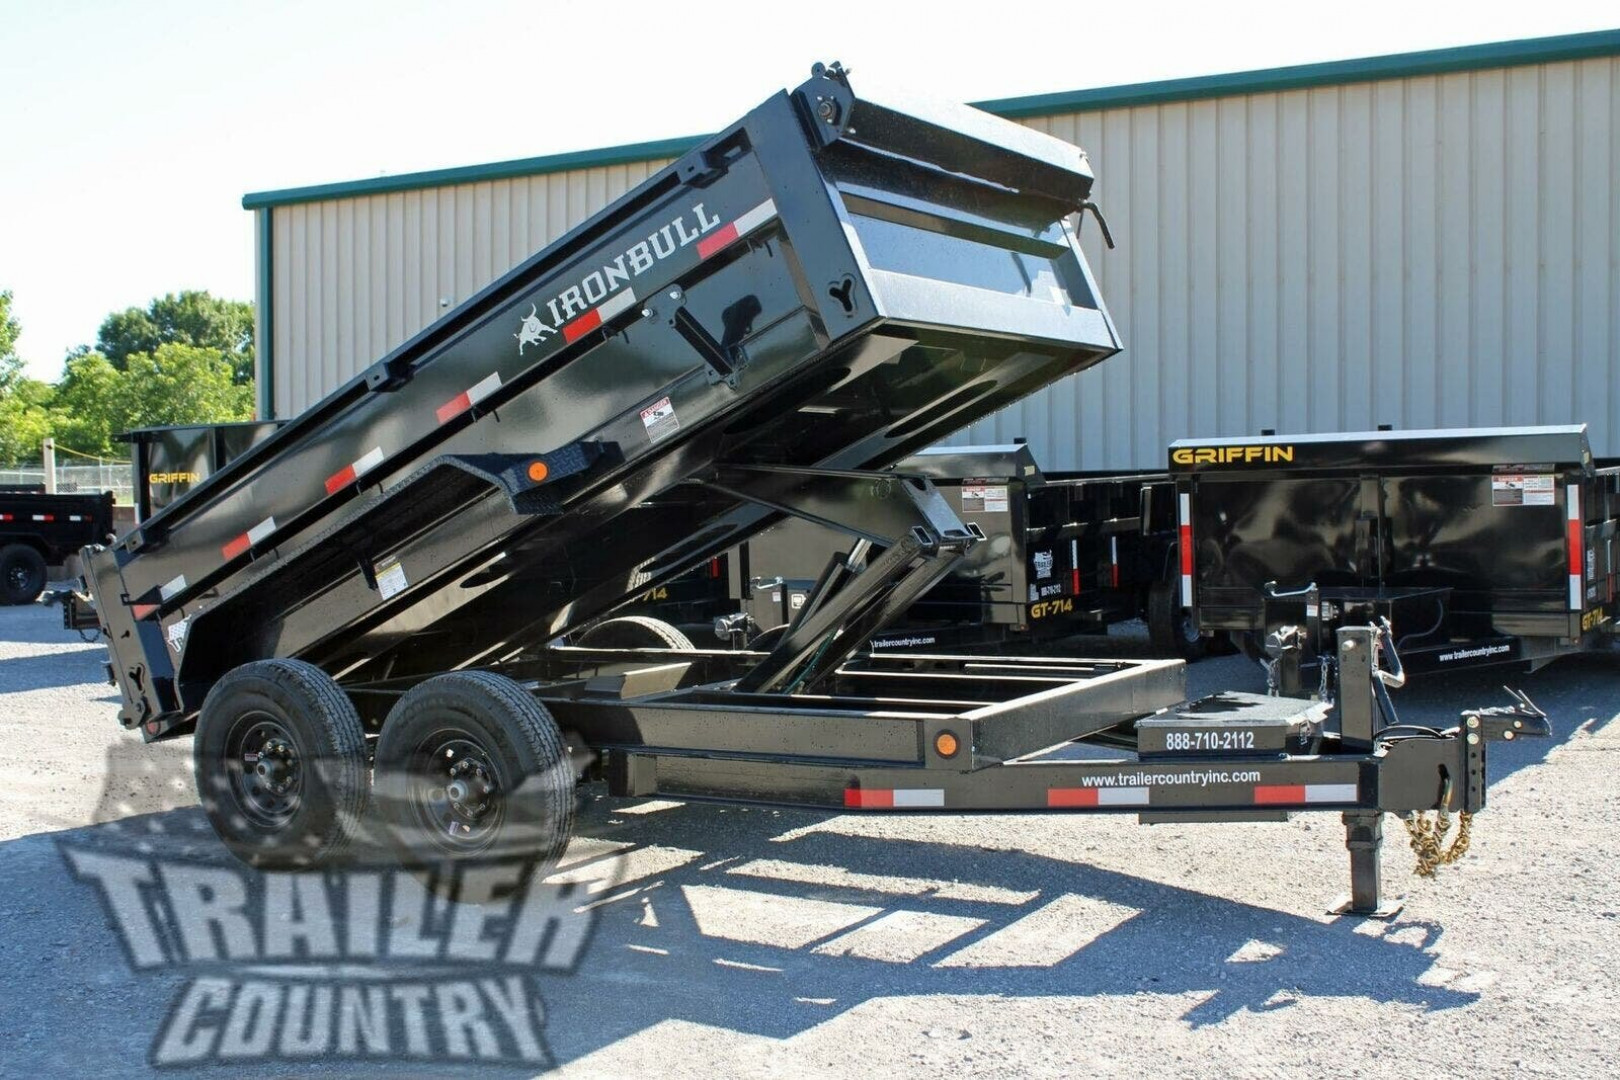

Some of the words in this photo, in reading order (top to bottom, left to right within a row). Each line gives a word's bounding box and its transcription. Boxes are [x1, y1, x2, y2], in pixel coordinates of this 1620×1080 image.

[546, 202, 721, 328] IRONBULL
[1172, 446, 1294, 464] GRIFFIN
[149, 472, 201, 483] GRIFFIN
[643, 587, 668, 601] 714
[1031, 598, 1073, 618] GT-714
[874, 637, 936, 648] trailercountryinc.com
[1165, 731, 1255, 750] 888-710-2112
[1081, 769, 1262, 787] www.trailercountryinc.com
